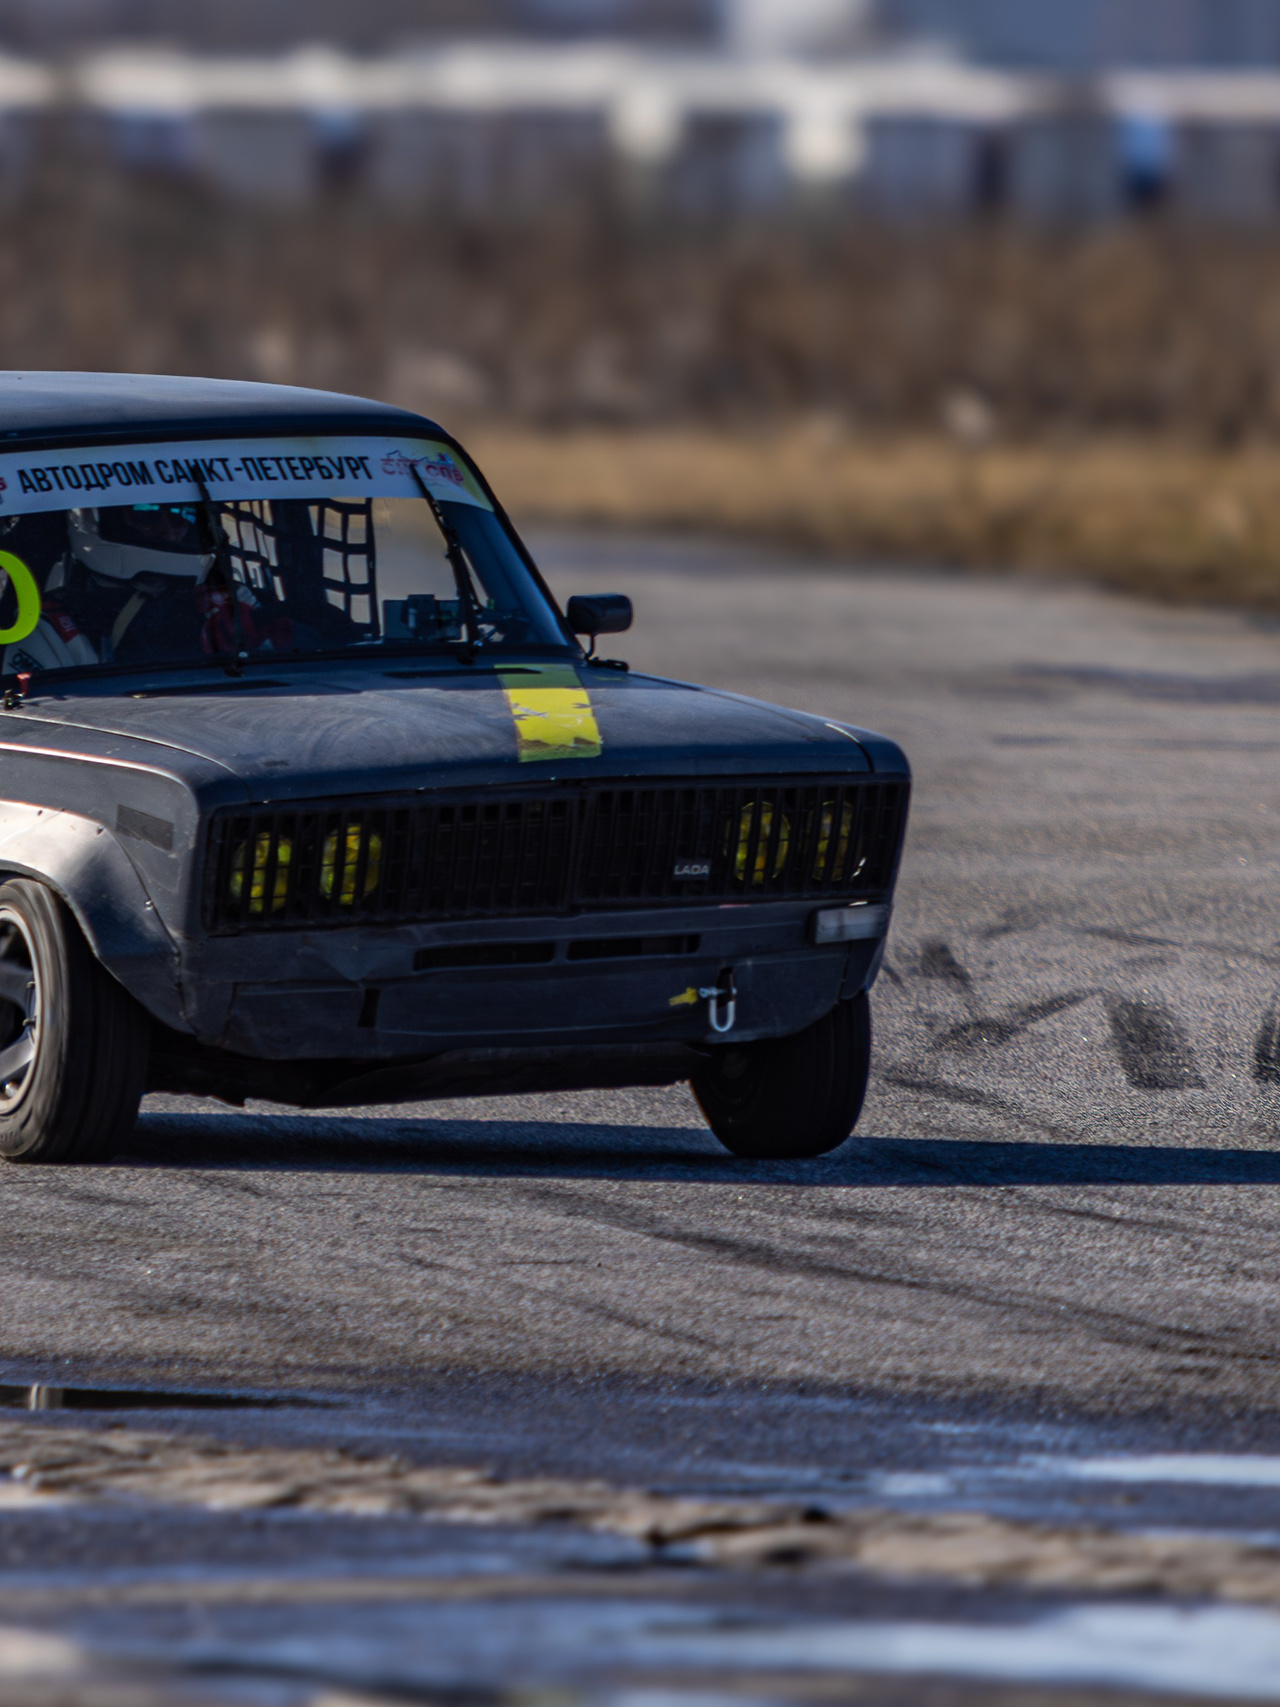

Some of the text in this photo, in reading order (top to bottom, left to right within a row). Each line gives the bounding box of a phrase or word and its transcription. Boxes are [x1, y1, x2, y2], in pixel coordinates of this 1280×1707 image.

[17, 456, 373, 494] АВТОДРОМ САНКТ-ПЕТЕРБУРГ
[673, 864, 710, 875] LADA
